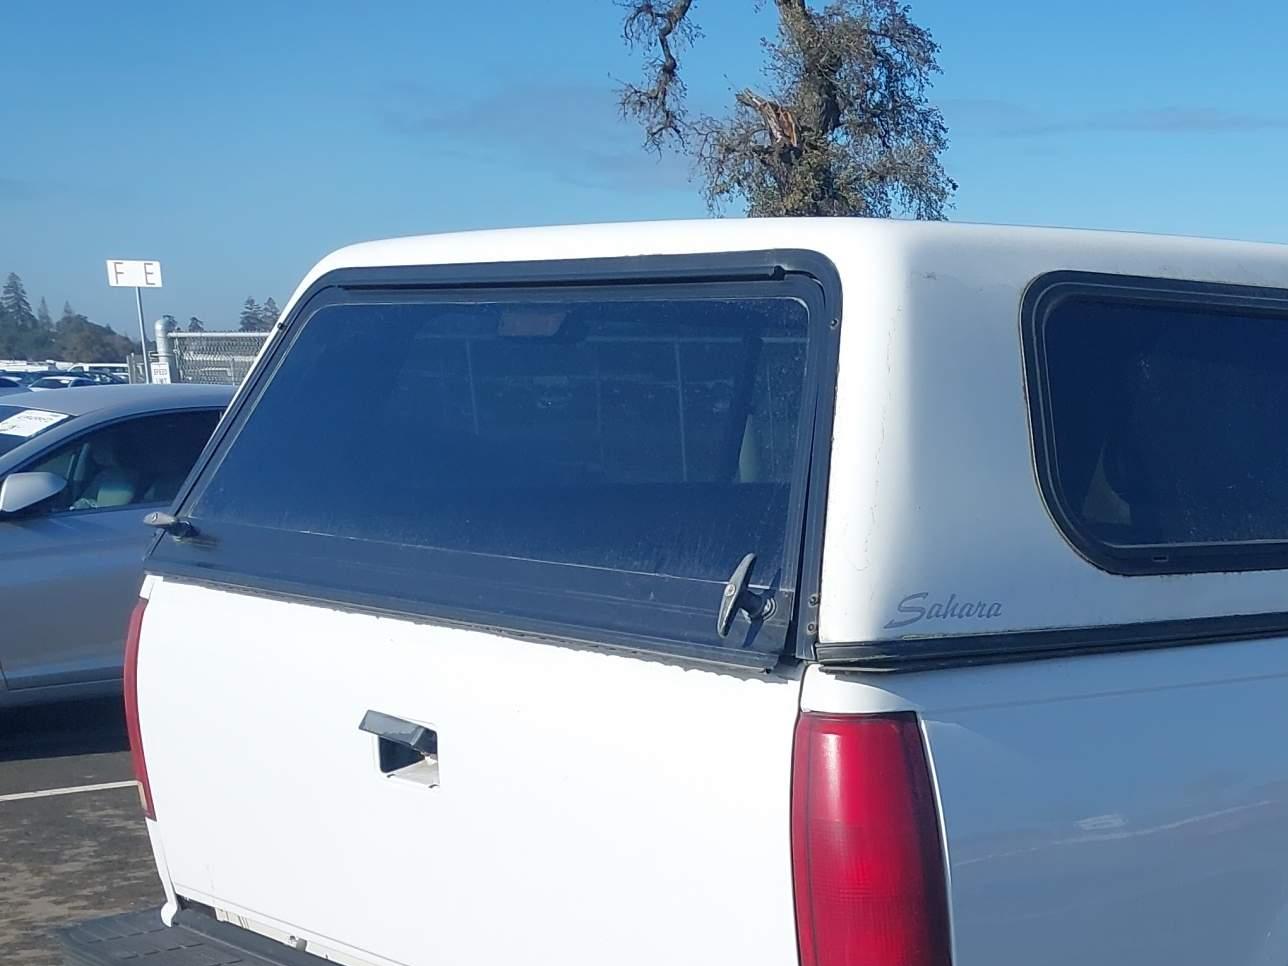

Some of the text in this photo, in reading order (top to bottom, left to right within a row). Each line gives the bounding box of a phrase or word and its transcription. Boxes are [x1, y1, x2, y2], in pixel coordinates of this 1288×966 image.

[112, 261, 156, 286] F E
[883, 591, 1003, 630] Sahara
